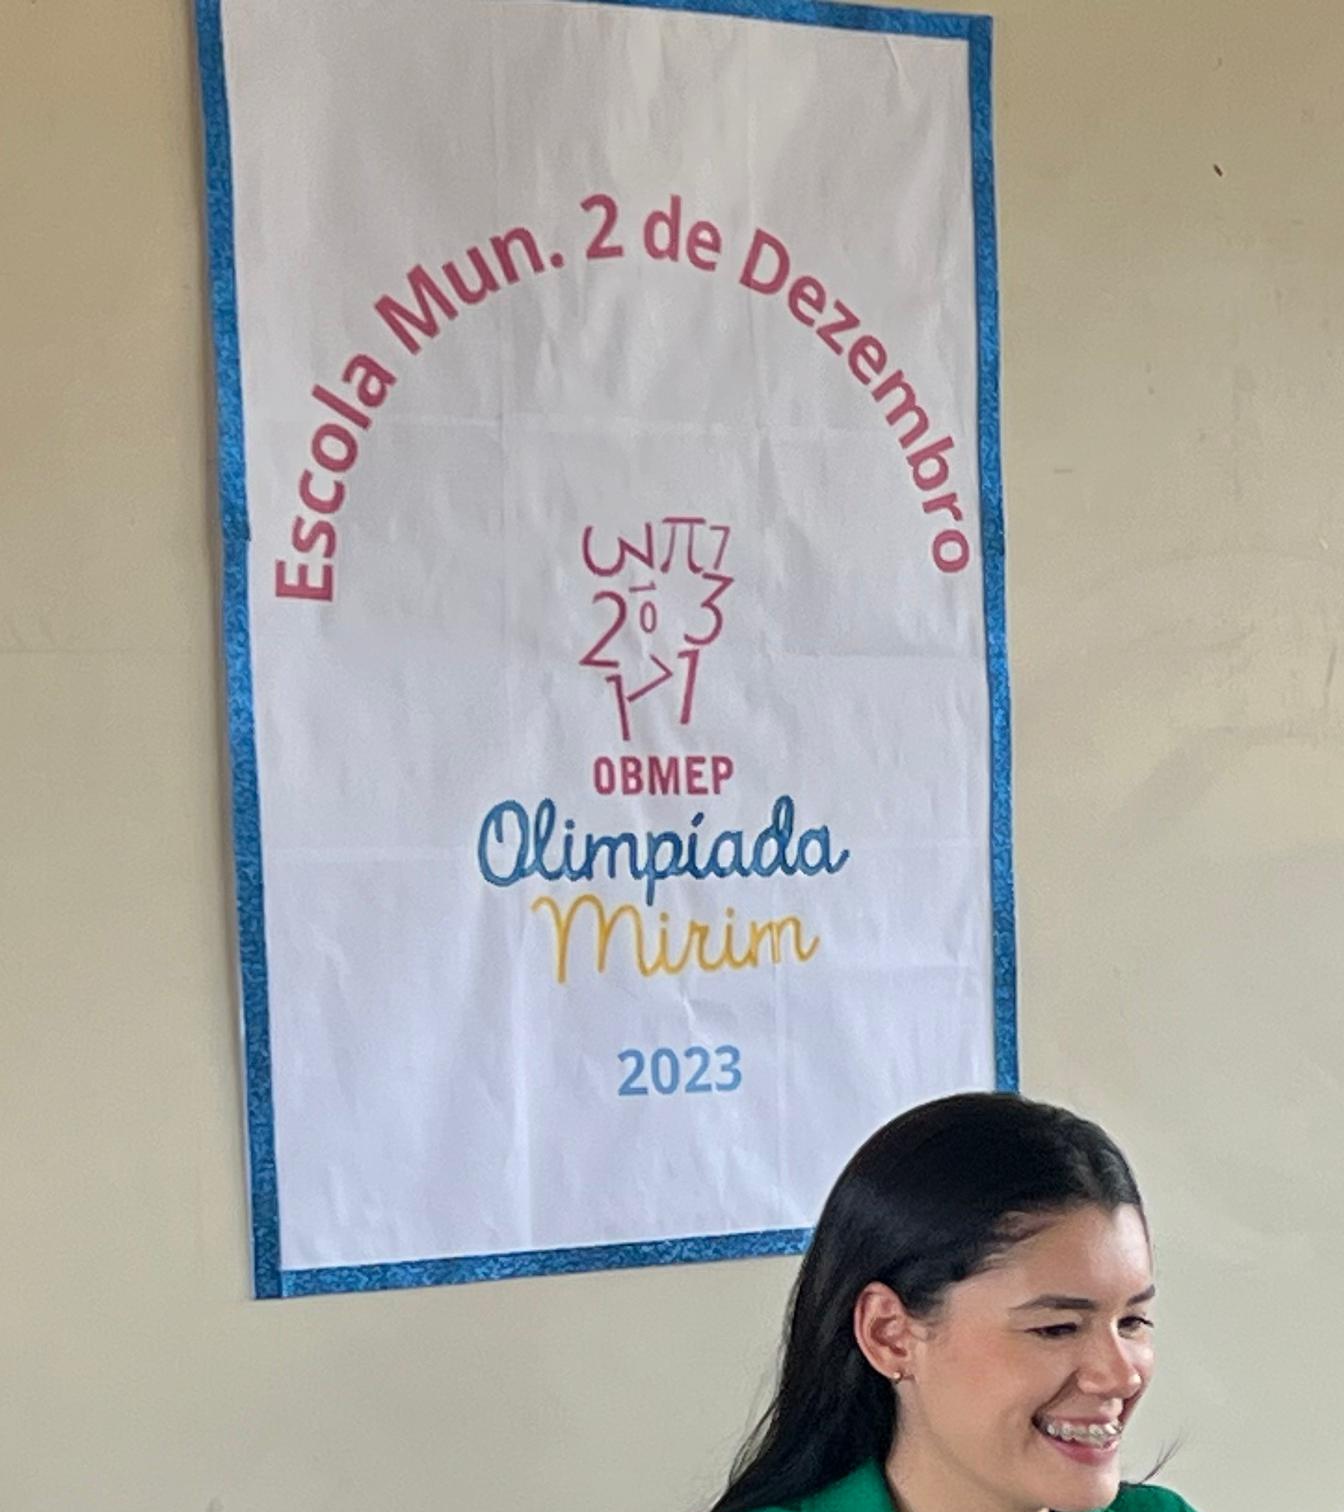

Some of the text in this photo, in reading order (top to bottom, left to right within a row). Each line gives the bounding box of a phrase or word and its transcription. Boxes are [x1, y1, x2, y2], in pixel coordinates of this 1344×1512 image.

[275, 193, 970, 602] Escola Mun. 2 de Dezembro
[593, 755, 734, 796] OBMEP
[477, 795, 850, 906] Olimpíada
[532, 893, 820, 983] Mirim
[617, 1045, 743, 1096] 2023
